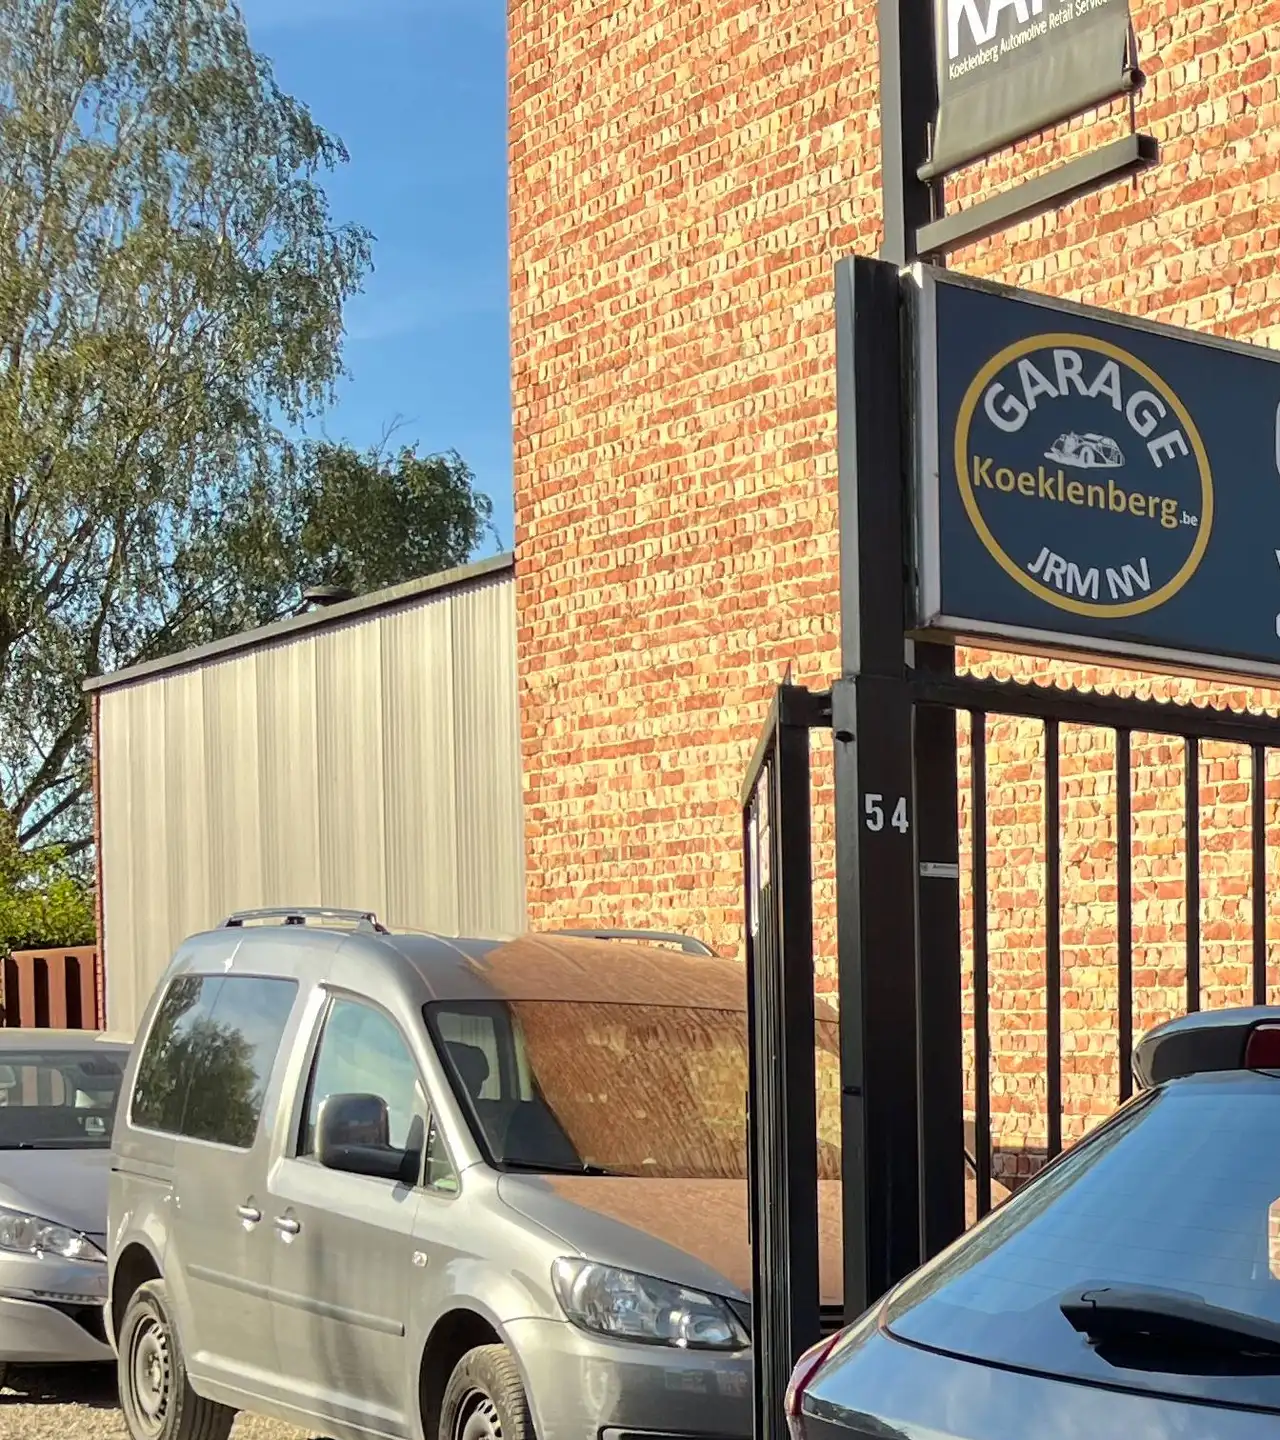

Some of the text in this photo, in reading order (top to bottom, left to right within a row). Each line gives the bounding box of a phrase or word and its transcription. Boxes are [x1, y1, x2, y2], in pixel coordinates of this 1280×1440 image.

[949, 44, 999, 80] Koeklenberg
[1000, 19, 1047, 56] Automotive
[1048, 4, 1074, 28] Retail
[984, 349, 1189, 468] GARAGE
[1027, 547, 1151, 599] JRM NV
[864, 793, 909, 833] 54
